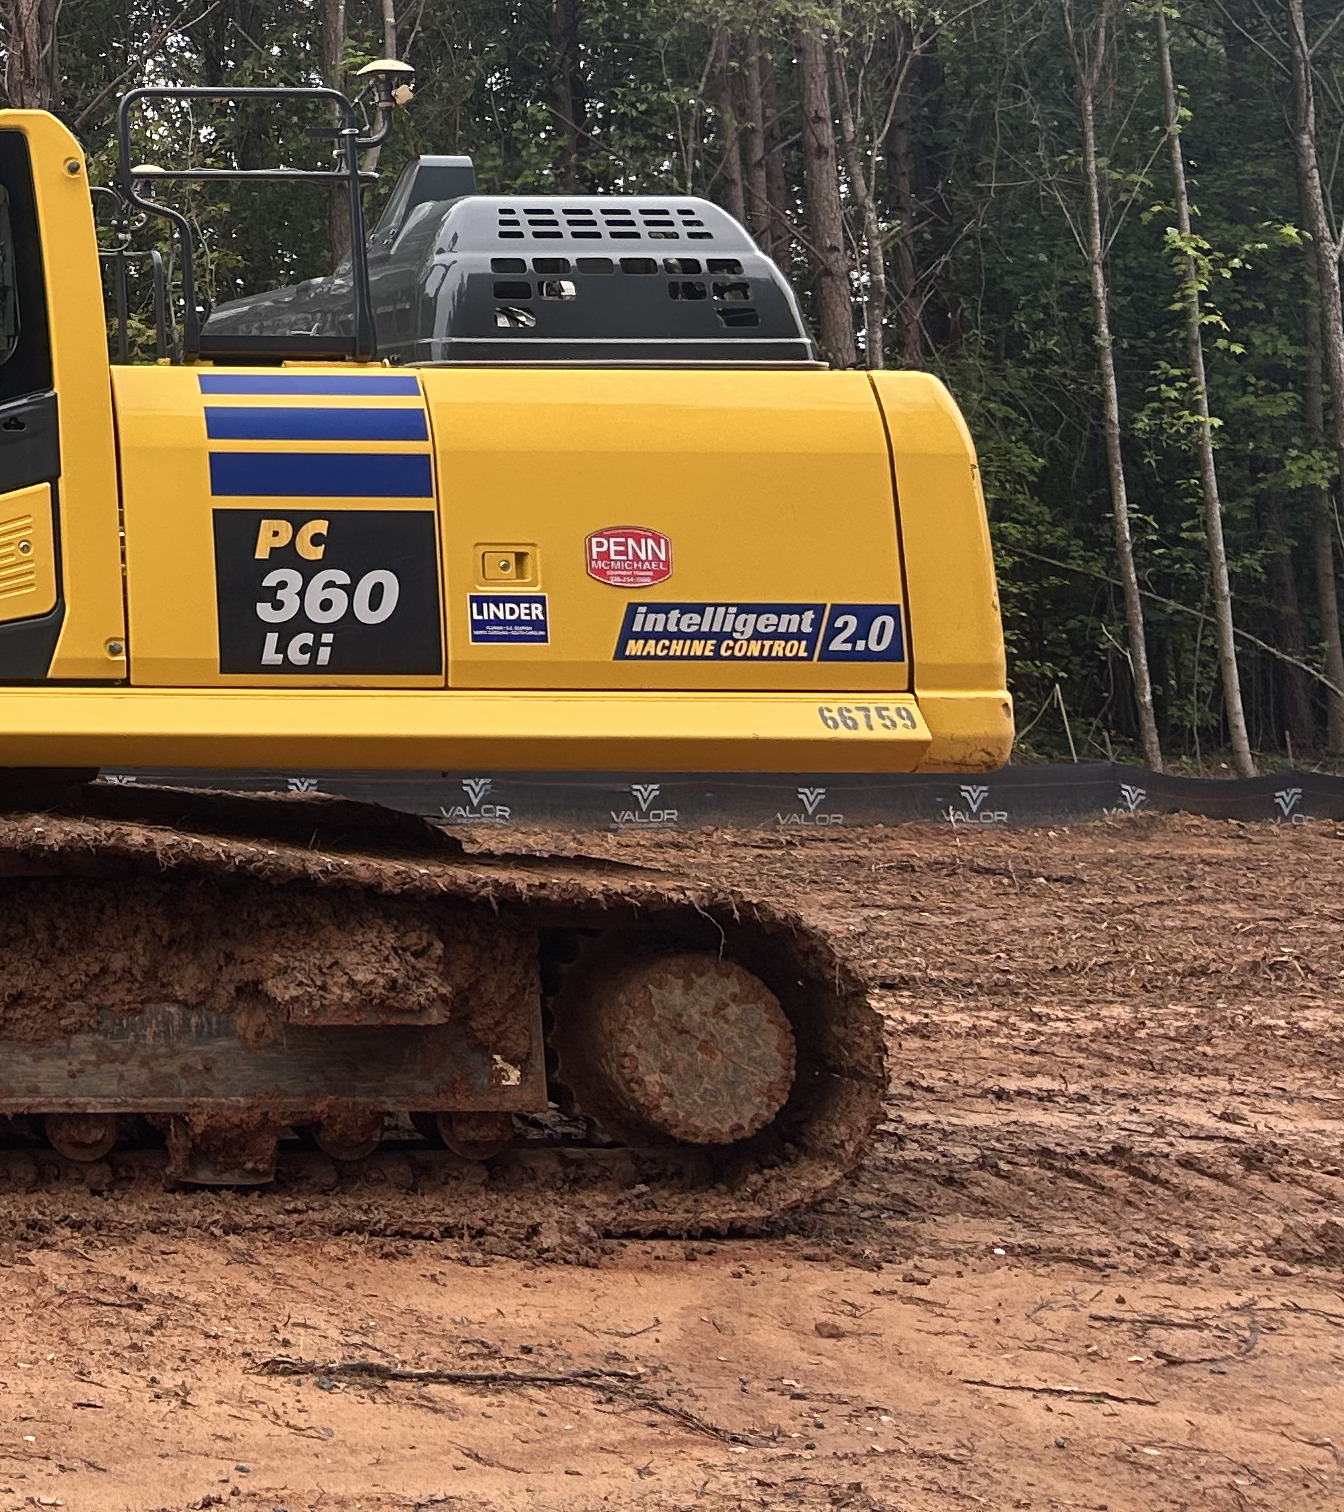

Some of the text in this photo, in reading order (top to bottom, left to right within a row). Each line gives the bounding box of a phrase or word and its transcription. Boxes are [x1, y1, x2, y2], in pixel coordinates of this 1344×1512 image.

[254, 519, 330, 561] PC
[591, 536, 667, 561] PENN
[256, 568, 400, 624] 360
[472, 602, 545, 620] LINDER
[631, 606, 815, 640] intelligent
[828, 615, 895, 652] 2.0
[261, 632, 334, 666] LCi
[624, 639, 809, 658] MACHINE CONTROL
[817, 706, 918, 731] 66759
[439, 804, 511, 819] VALOR
[610, 809, 678, 823] VALOR
[776, 812, 844, 826] VALOR
